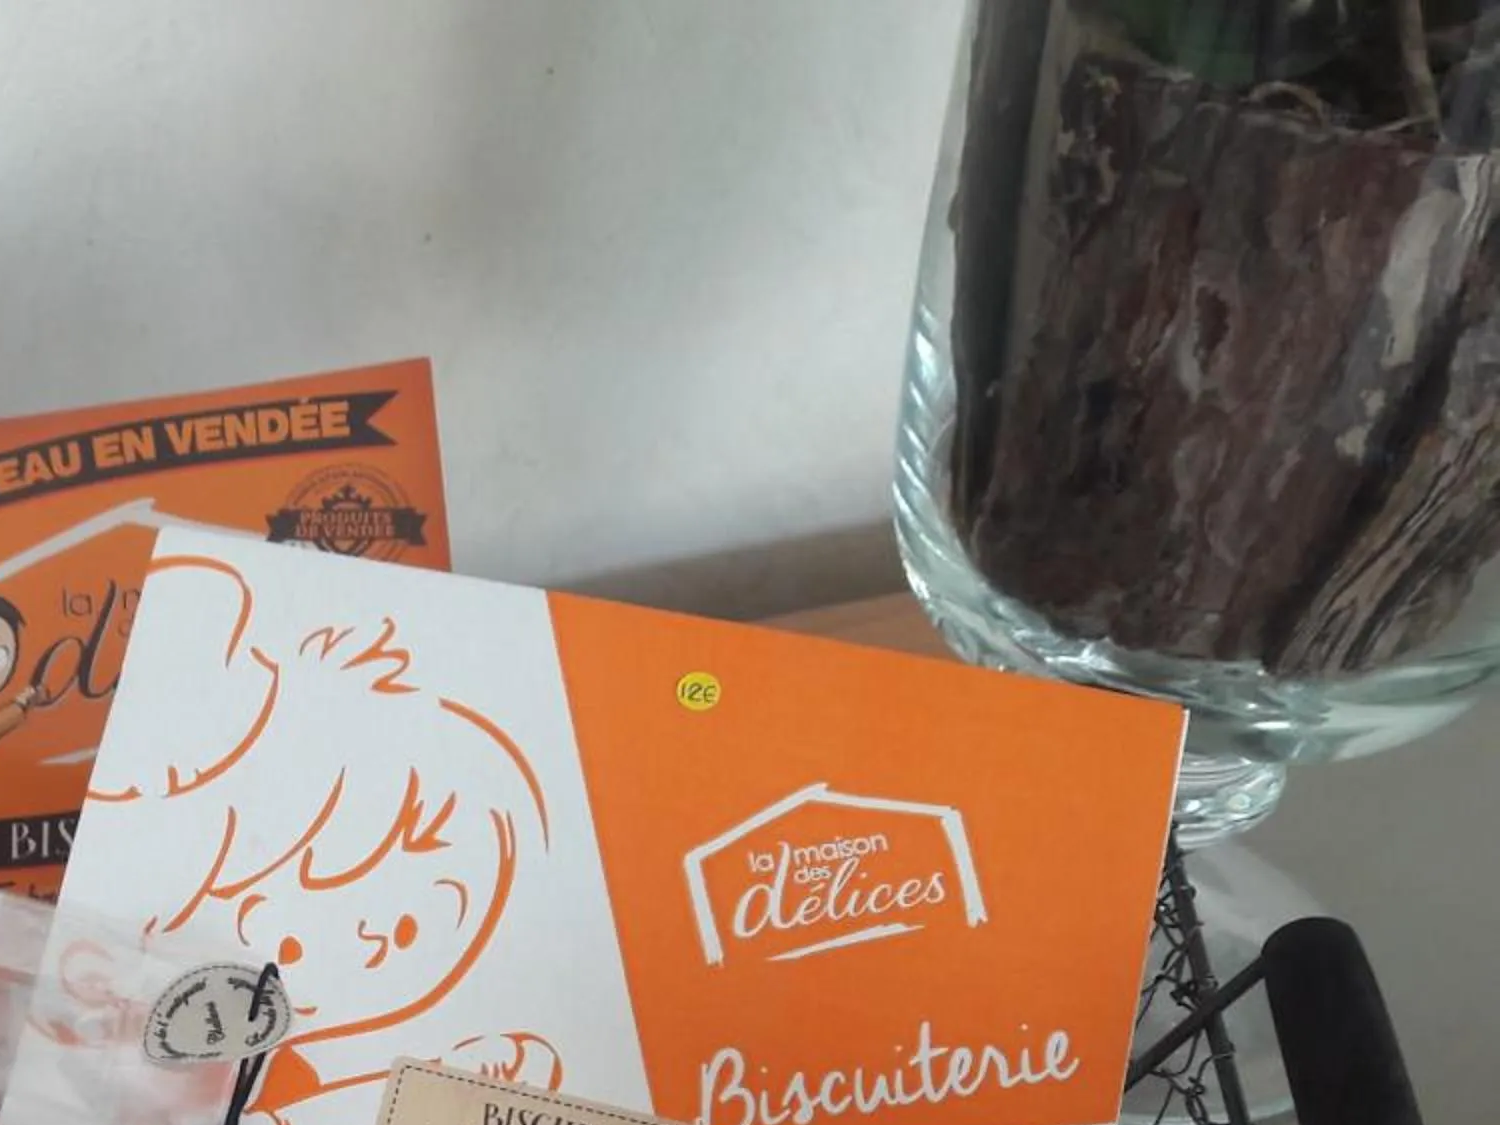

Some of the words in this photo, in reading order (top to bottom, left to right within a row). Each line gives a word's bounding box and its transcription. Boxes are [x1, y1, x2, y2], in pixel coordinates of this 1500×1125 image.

[91, 427, 156, 472] EN
[163, 397, 350, 455] VENDÉE
[749, 851, 774, 873] la
[793, 833, 888, 864] maison
[793, 864, 832, 884] des
[732, 841, 946, 939] délices
